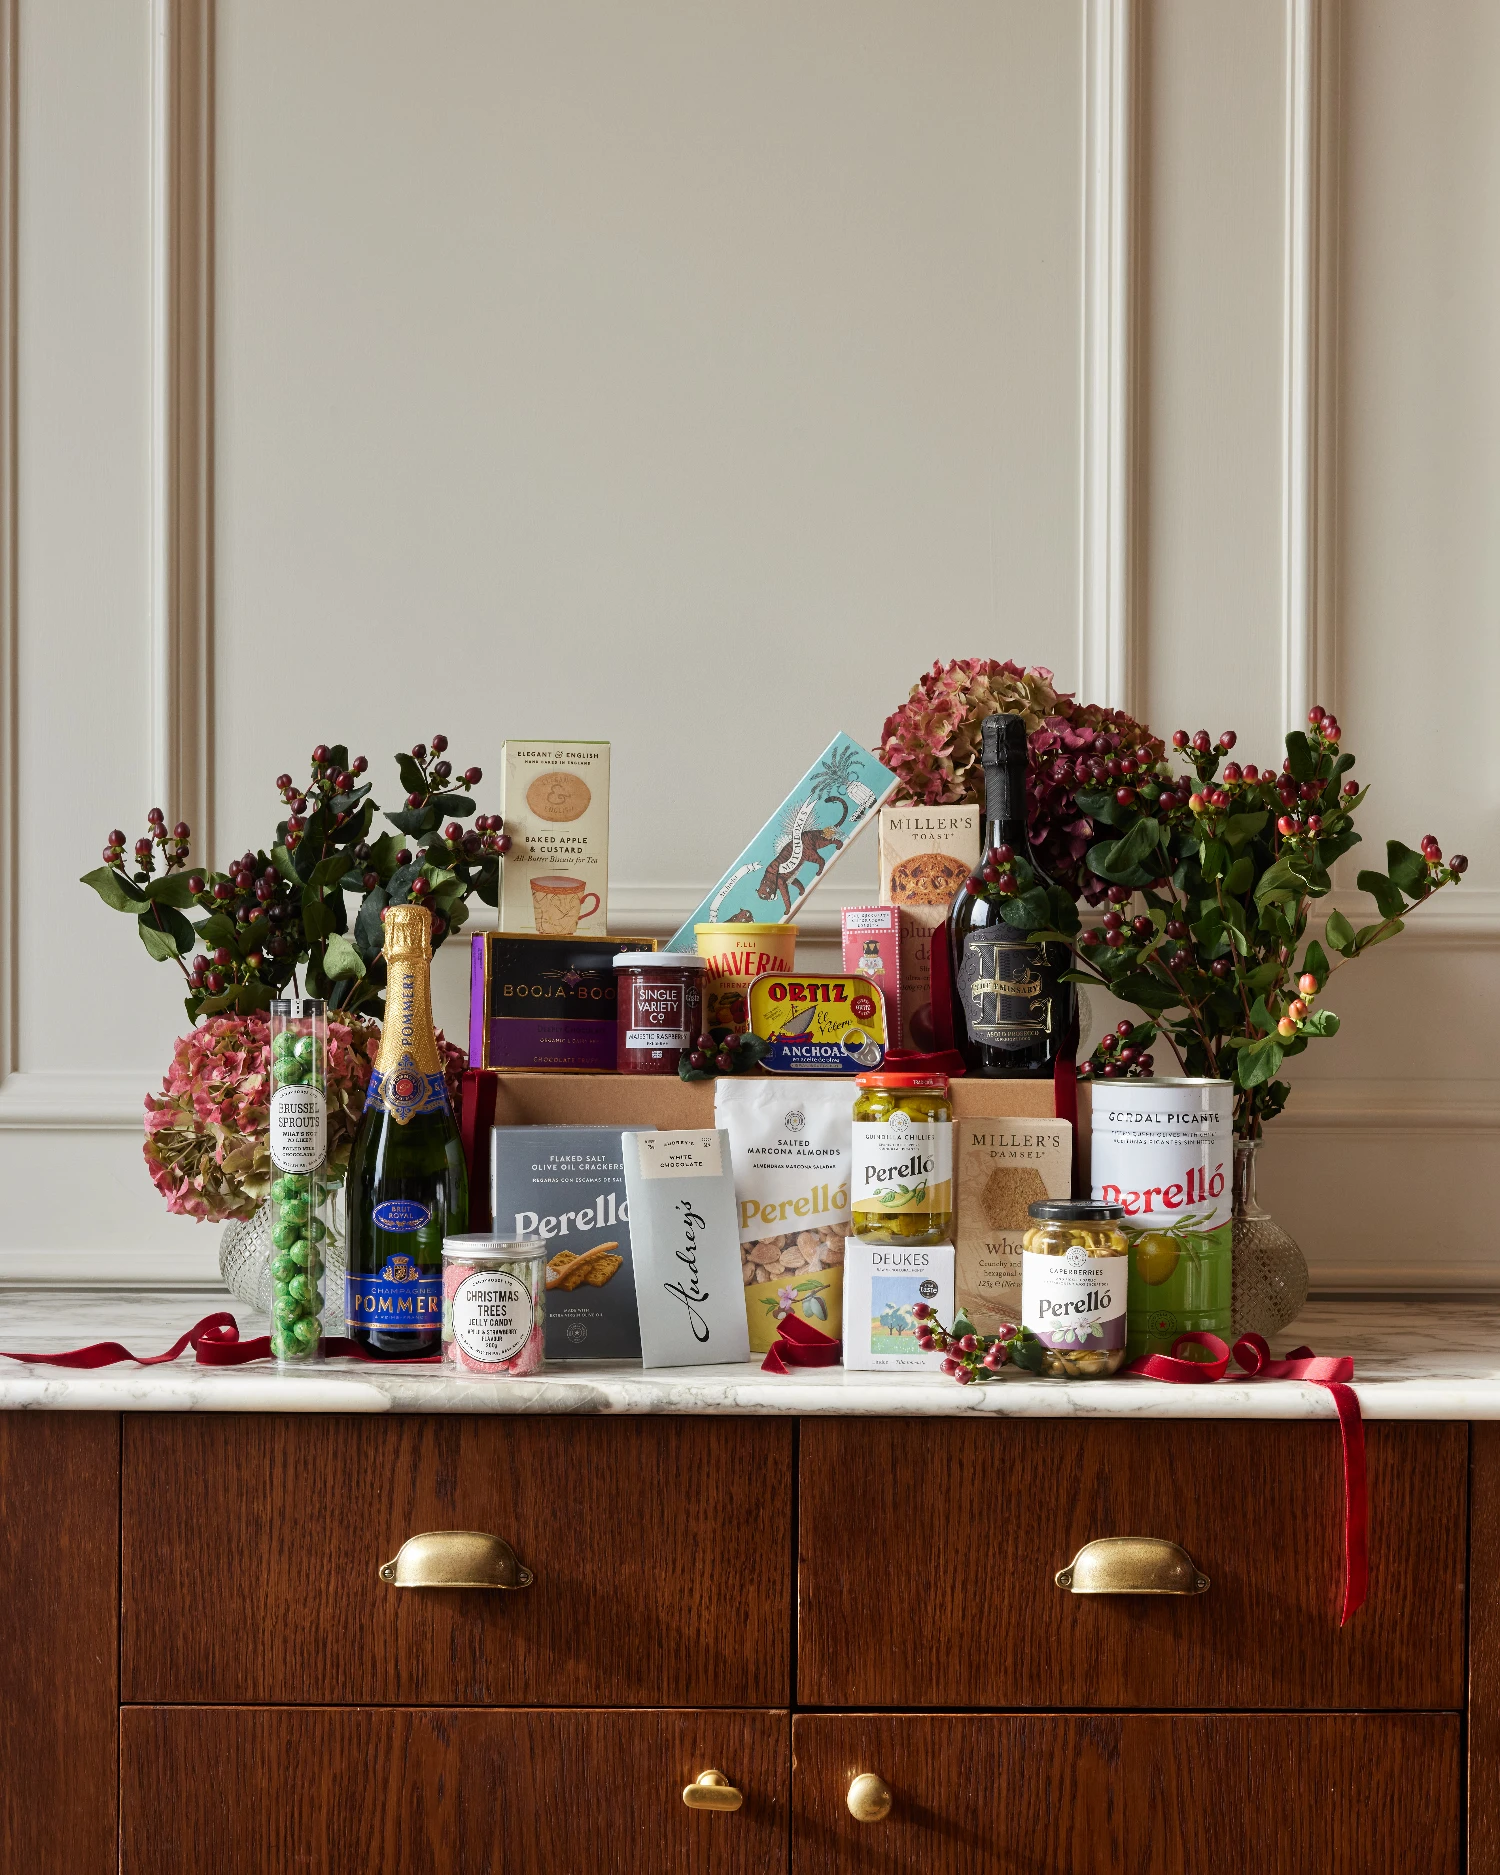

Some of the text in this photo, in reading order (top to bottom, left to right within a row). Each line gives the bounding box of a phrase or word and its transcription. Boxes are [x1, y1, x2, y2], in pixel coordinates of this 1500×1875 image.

[554, 750, 564, 759] &
[890, 818, 972, 830] MILLER'S
[540, 846, 583, 854] CUSTARD
[503, 984, 616, 1000] BOOJA-BOO
[768, 982, 848, 1003] ORTIZ
[993, 982, 1038, 994] EMISSARY
[639, 990, 677, 1000] SINGLE
[401, 974, 415, 1047] POMMERY
[637, 1001, 678, 1012] VARIETY
[782, 1046, 848, 1057] ANCHOAS
[532, 1056, 575, 1064] CHOCOLATE
[278, 1102, 320, 1114] BRUSSEL
[278, 1116, 320, 1128] SPROUTS
[1108, 1112, 1220, 1124] GORDAL PICANTE
[972, 1134, 1060, 1148] MILLER'S
[747, 1147, 793, 1155] MARCONA
[864, 1154, 935, 1186] Perelló
[740, 1182, 848, 1229] Perelló
[985, 1237, 1023, 1255] whe
[872, 1252, 929, 1266] DEUKES
[978, 1259, 1008, 1269] Crunchy
[663, 1199, 710, 1343] Audrey's
[1049, 1267, 1104, 1276] CAPERBERRIES
[466, 1290, 519, 1302] CHRISTMAS
[354, 1294, 442, 1314] POMMER
[1039, 1290, 1112, 1319] Perelló
[477, 1305, 507, 1317] TREES
[468, 1318, 513, 1327] JELLY CANDY
